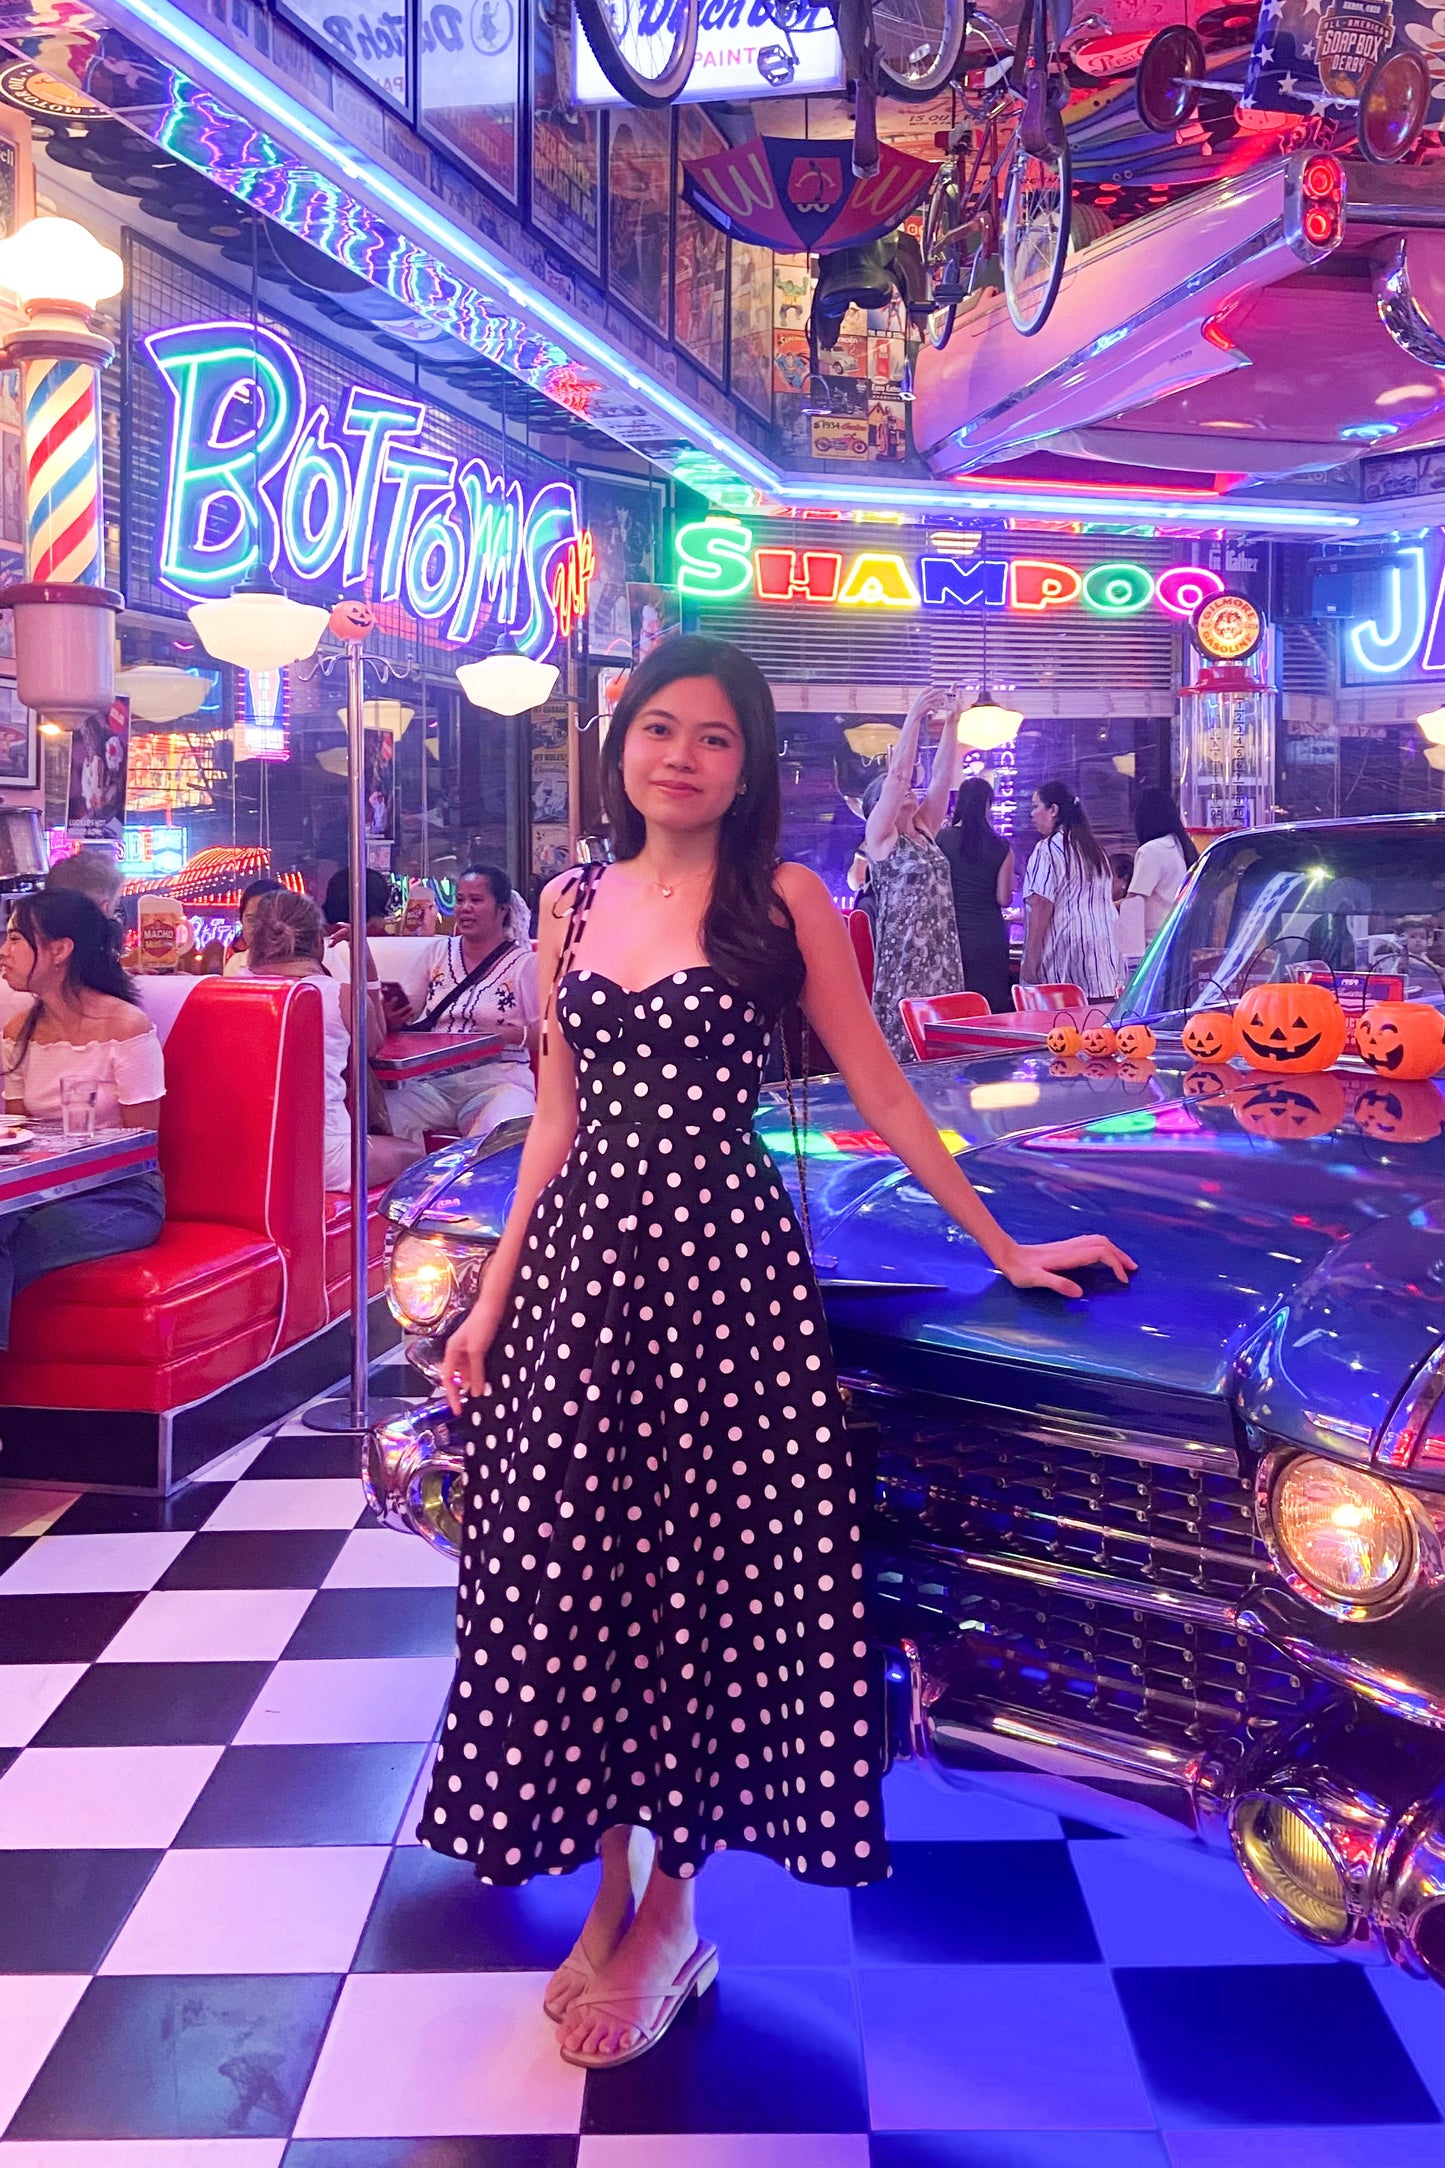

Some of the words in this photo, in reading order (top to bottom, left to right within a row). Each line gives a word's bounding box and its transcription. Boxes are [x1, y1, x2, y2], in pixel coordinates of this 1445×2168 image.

[1331, 54, 1366, 73] DERBY
[675, 521, 1225, 615] SHAMPOO
[1203, 598, 1257, 620] GILMORE
[1203, 631, 1252, 653] GASOLINE
[143, 929, 174, 940] MACHO
